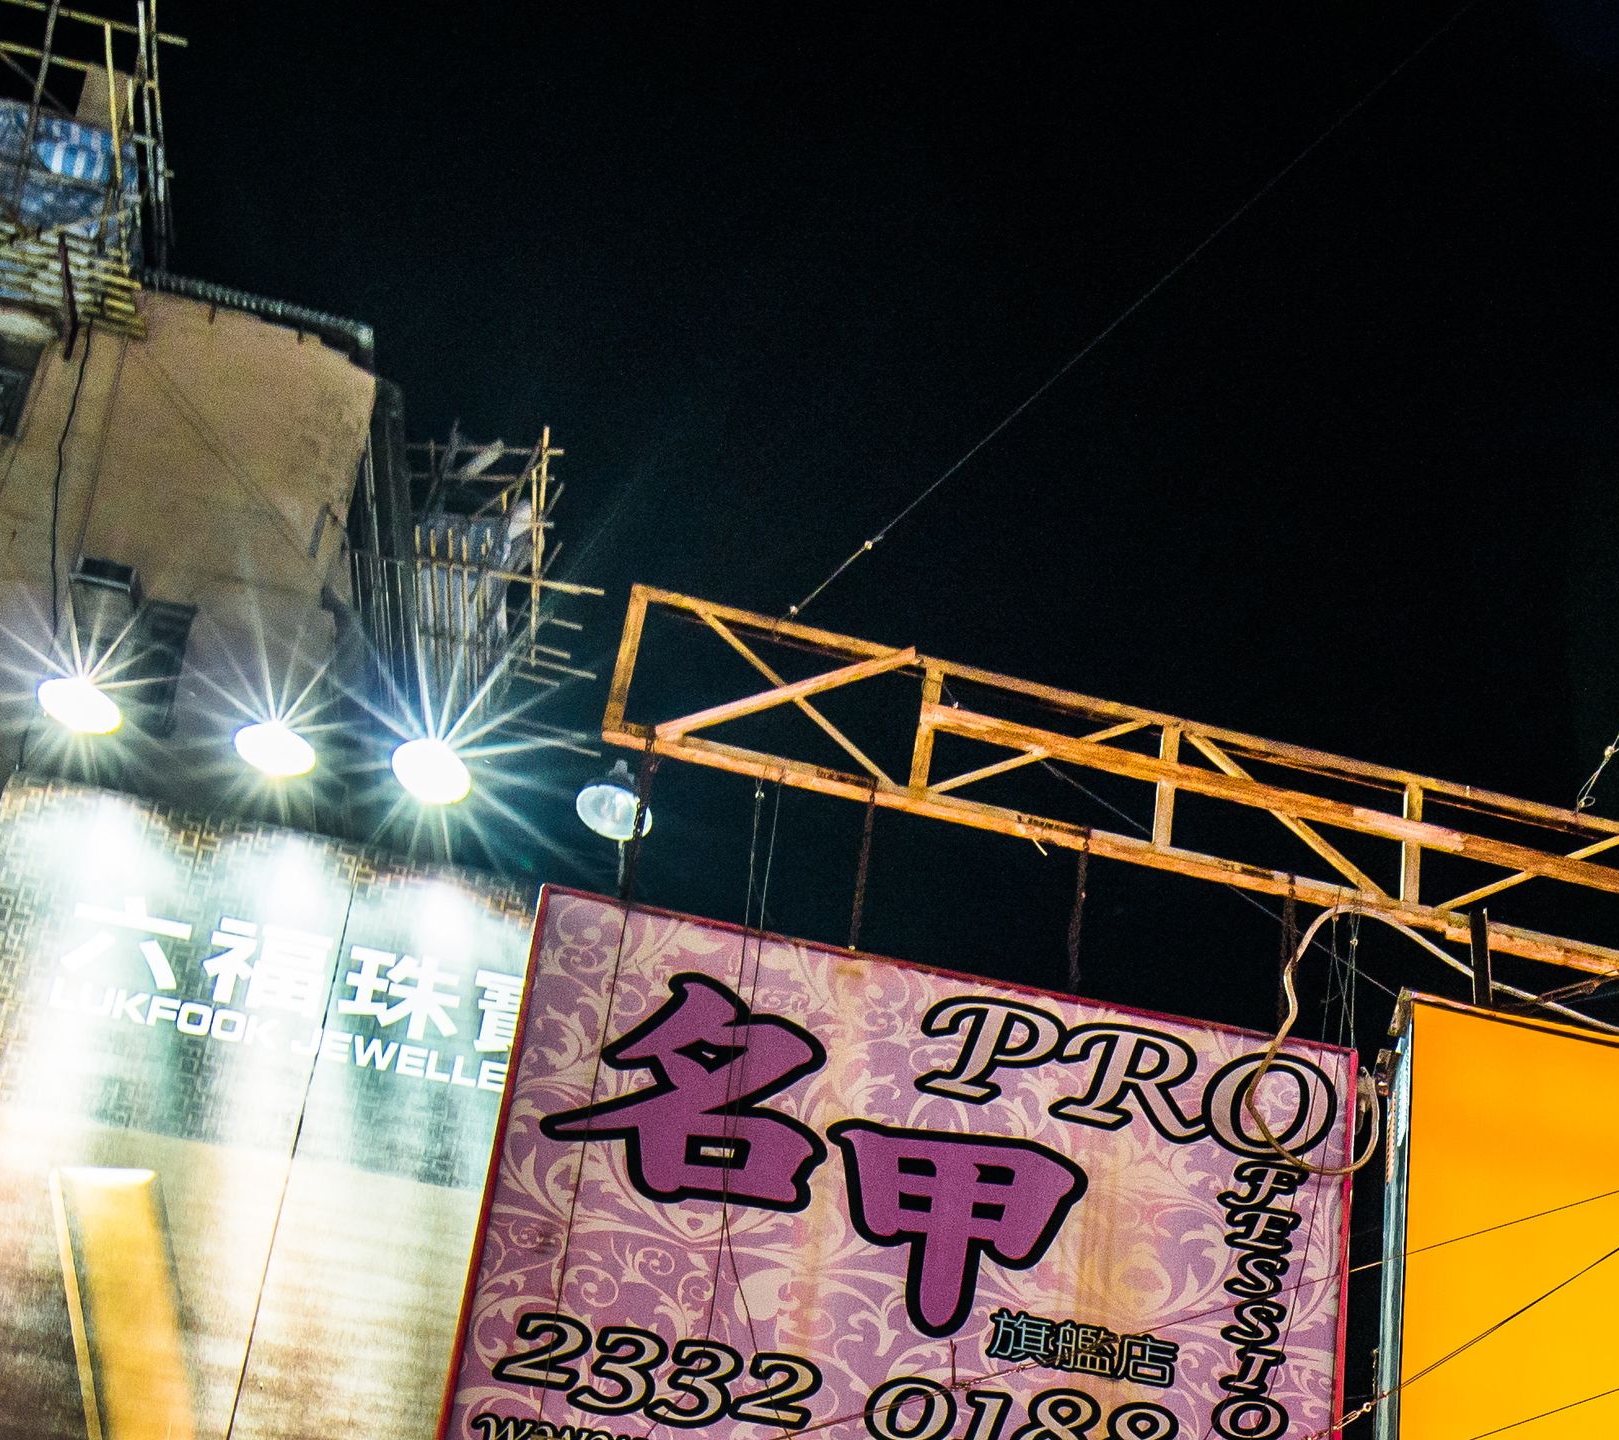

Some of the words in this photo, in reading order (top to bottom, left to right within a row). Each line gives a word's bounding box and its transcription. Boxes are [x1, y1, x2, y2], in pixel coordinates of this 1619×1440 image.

[493, 1312, 825, 1431] 2332
[985, 1306, 1181, 1390] 旗艦店
